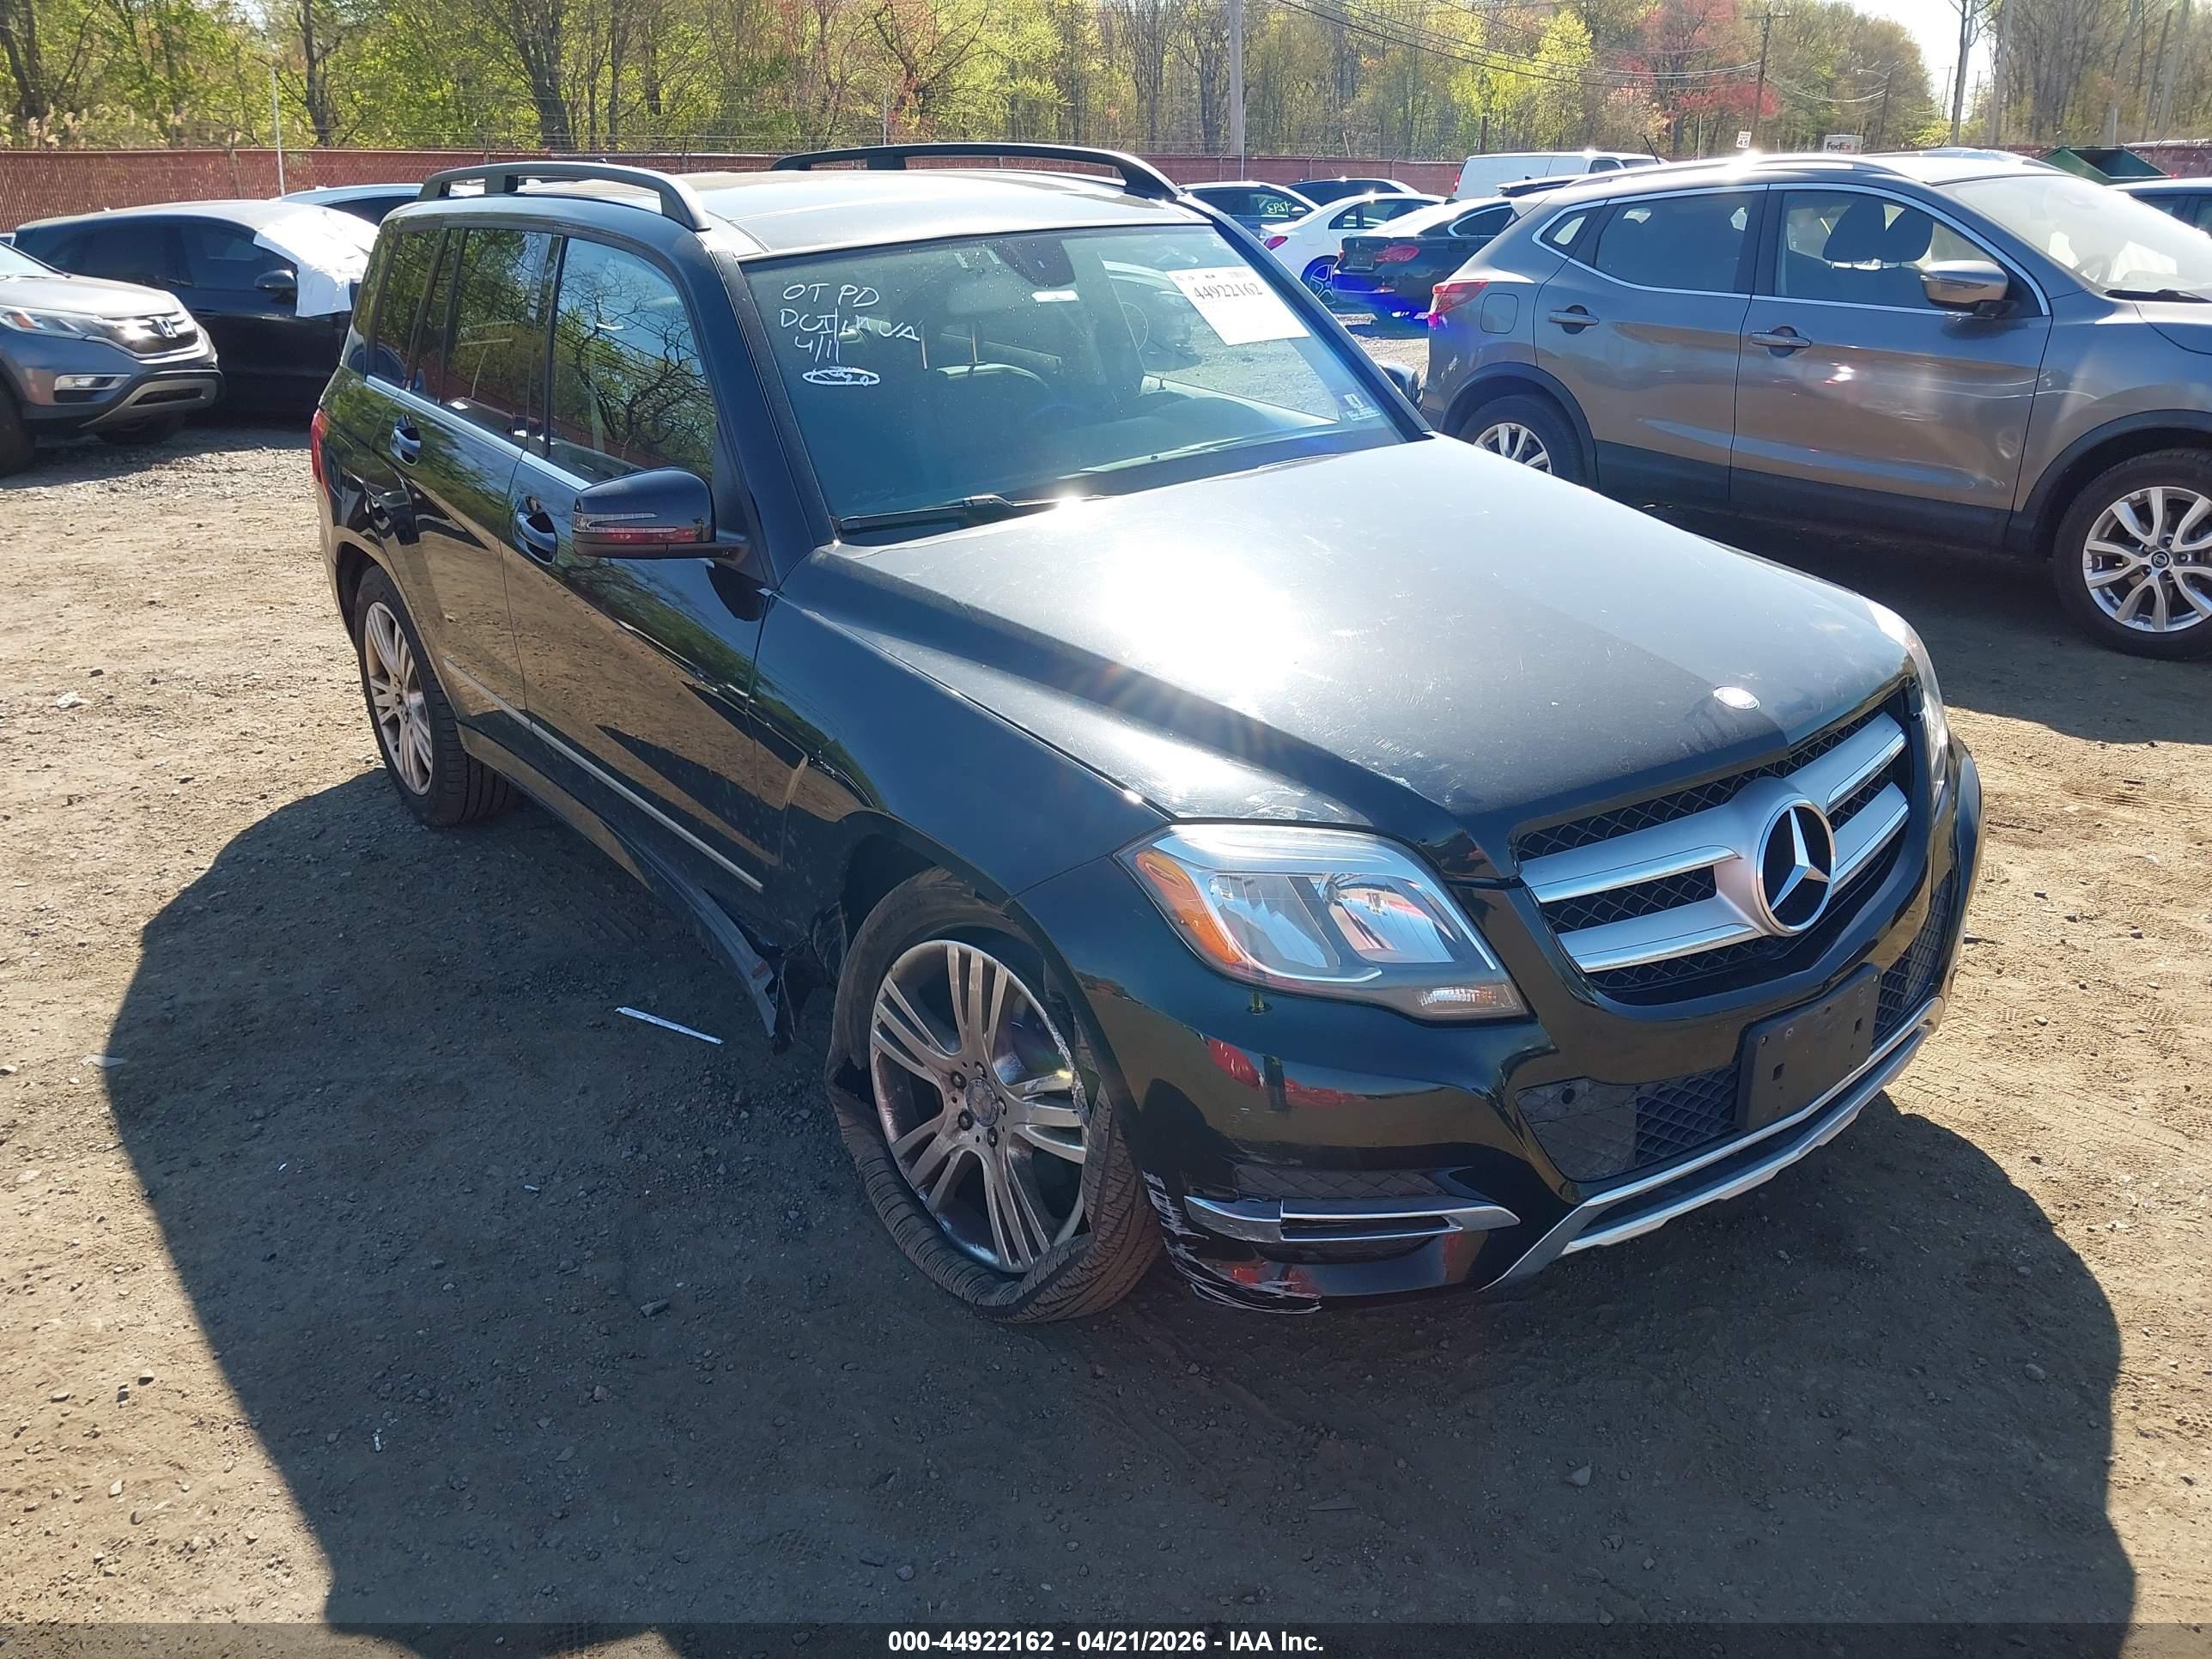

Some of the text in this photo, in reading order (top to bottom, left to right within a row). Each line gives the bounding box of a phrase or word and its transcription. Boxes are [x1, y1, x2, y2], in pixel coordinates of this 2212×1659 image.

[1826, 142, 1852, 150] FedEx
[838, 284, 880, 307] PD
[1194, 283, 1263, 300] 44922162
